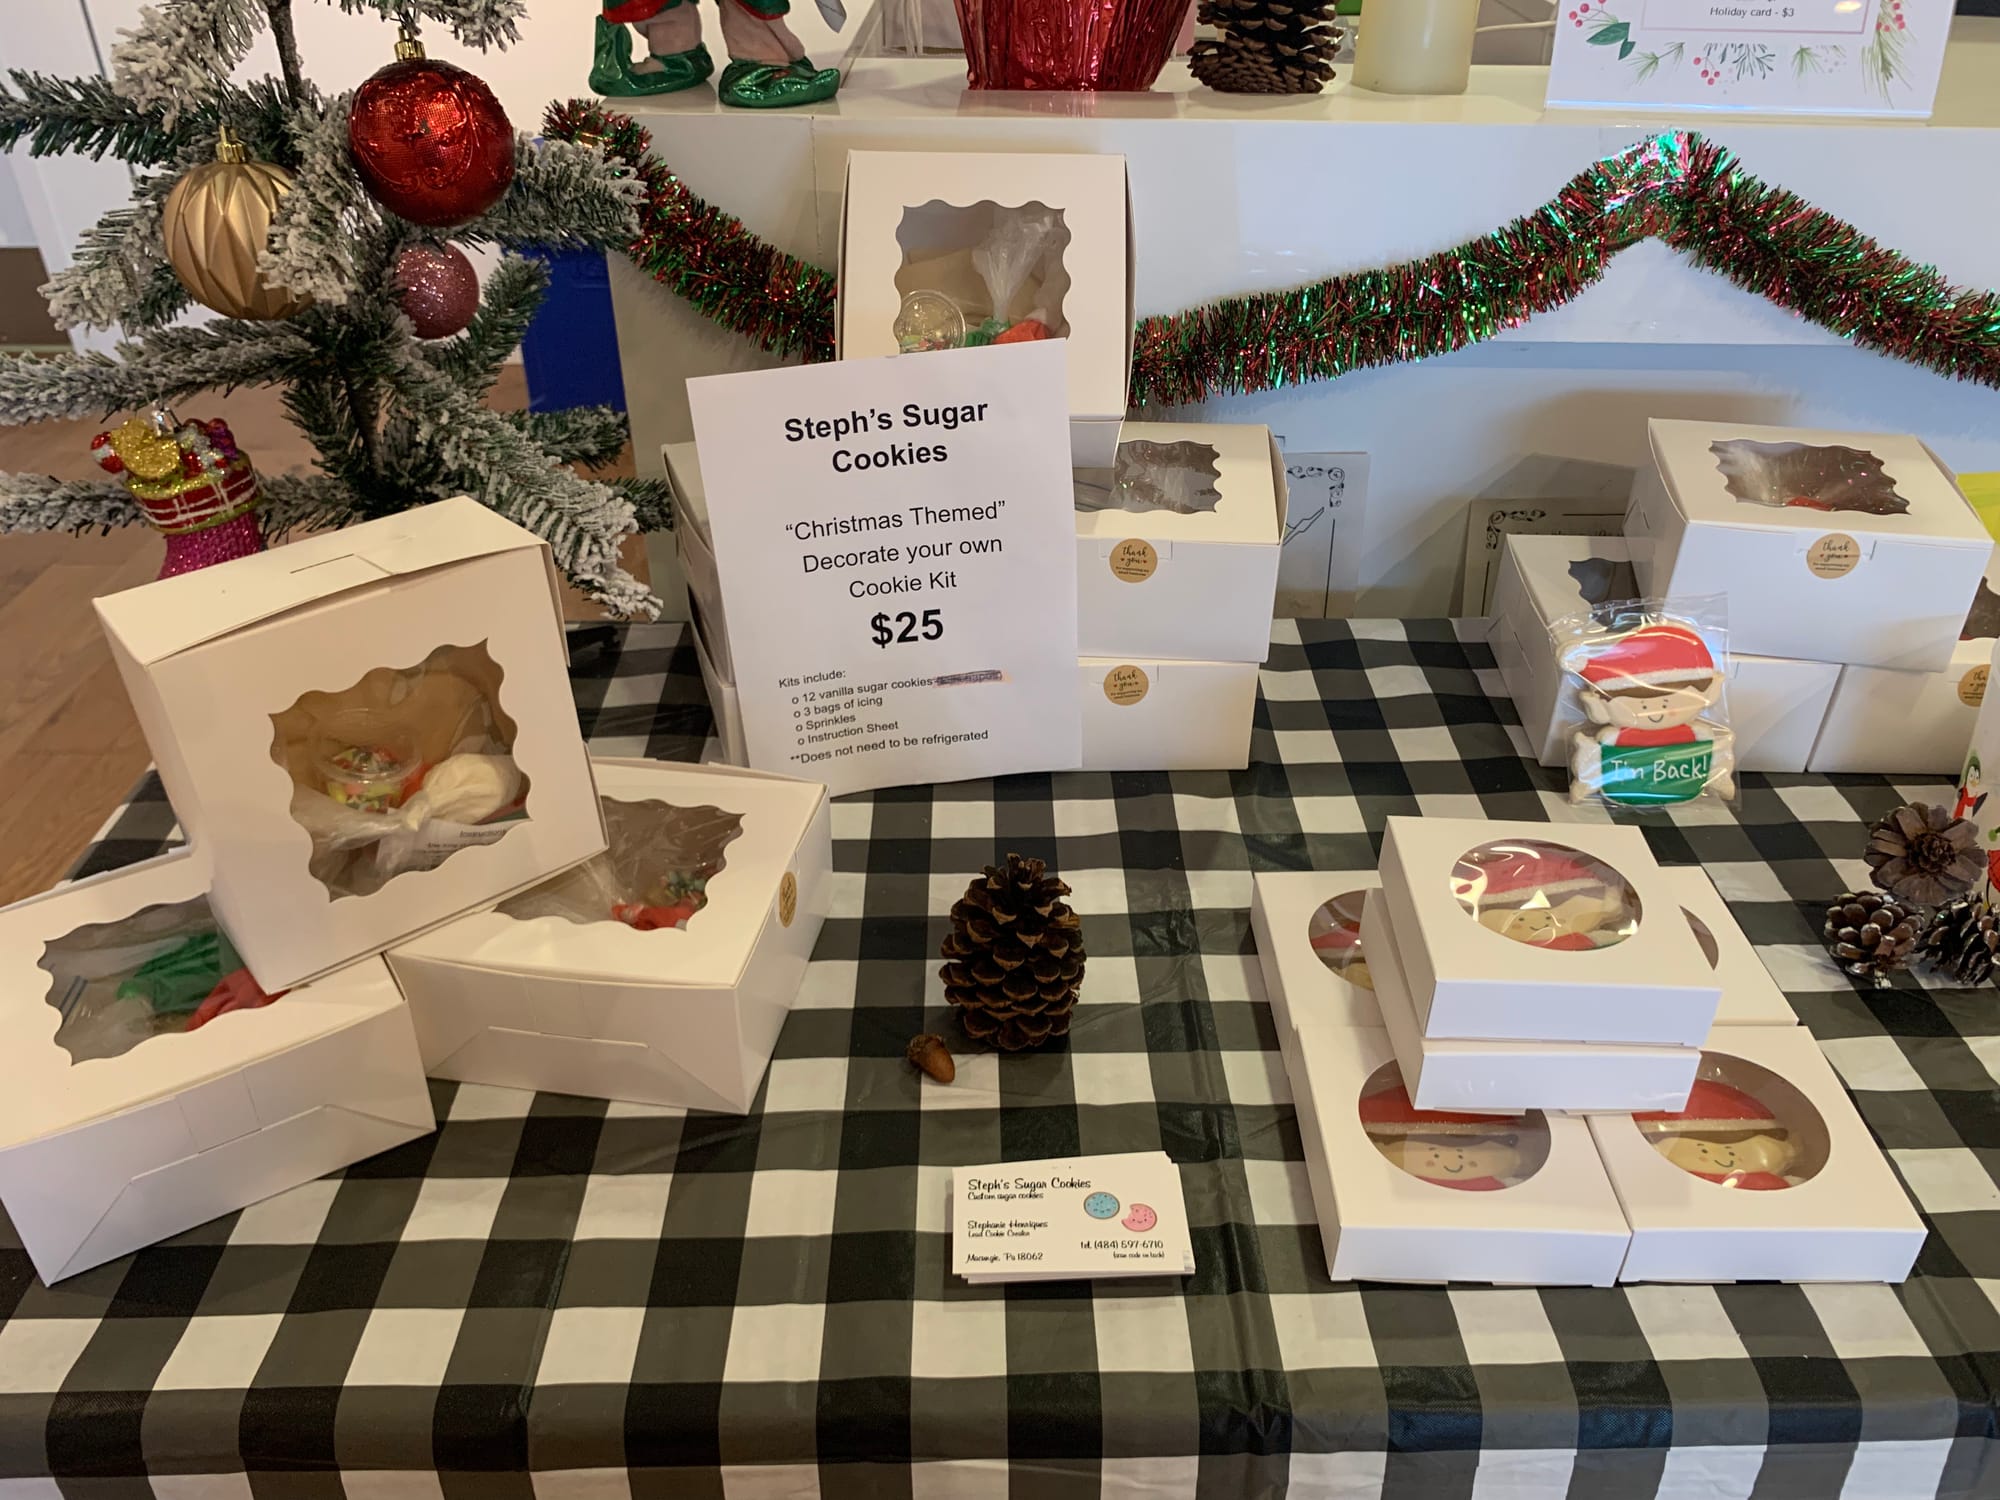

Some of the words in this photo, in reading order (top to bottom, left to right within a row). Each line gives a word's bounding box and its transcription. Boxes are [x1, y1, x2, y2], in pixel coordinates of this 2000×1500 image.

[1709, 7, 1747, 19] Holiday
[1750, 8, 1772, 17] card
[1781, 7, 1795, 18] $3
[784, 408, 893, 442] Steph’s
[902, 403, 988, 430] Sugar
[832, 442, 948, 473] Cookies
[785, 513, 903, 540] “Christmas
[909, 500, 1006, 526] Themed”
[802, 545, 900, 573] Decorate
[906, 541, 953, 564] your
[959, 538, 1003, 555] own
[1122, 545, 1147, 557] thank
[849, 575, 922, 598] Cookie
[929, 571, 957, 589] Kit
[870, 608, 944, 649] $25
[778, 677, 800, 689] Kits
[803, 669, 846, 685] include:
[1114, 669, 1137, 681] thank
[802, 692, 816, 702] 12
[818, 687, 854, 700] vanilla
[857, 681, 888, 696] sugar
[803, 706, 811, 717] 3
[814, 701, 841, 717] bags
[844, 698, 854, 709] of
[857, 695, 883, 708] icing
[806, 713, 856, 731] Sprinkles
[807, 727, 863, 744] Instruction
[866, 721, 899, 734] Sheet
[835, 745, 853, 759] not
[856, 740, 886, 753] need
[889, 738, 900, 748] to
[903, 735, 919, 747] be
[921, 730, 989, 746] refrigerated
[1653, 755, 1707, 784] Back!
[968, 1179, 1010, 1192] Steph's
[1014, 1178, 1047, 1192] Sugar
[1051, 1176, 1091, 1188] Cookies
[968, 1192, 996, 1200] Custom
[997, 1193, 1017, 1201] sugar
[1018, 1191, 1044, 1199] cookies
[967, 1220, 1006, 1232] Stephanie
[1094, 1240, 1119, 1249] (484)
[1003, 1252, 1016, 1261] Pa
[1017, 1251, 1043, 1261] 18062
